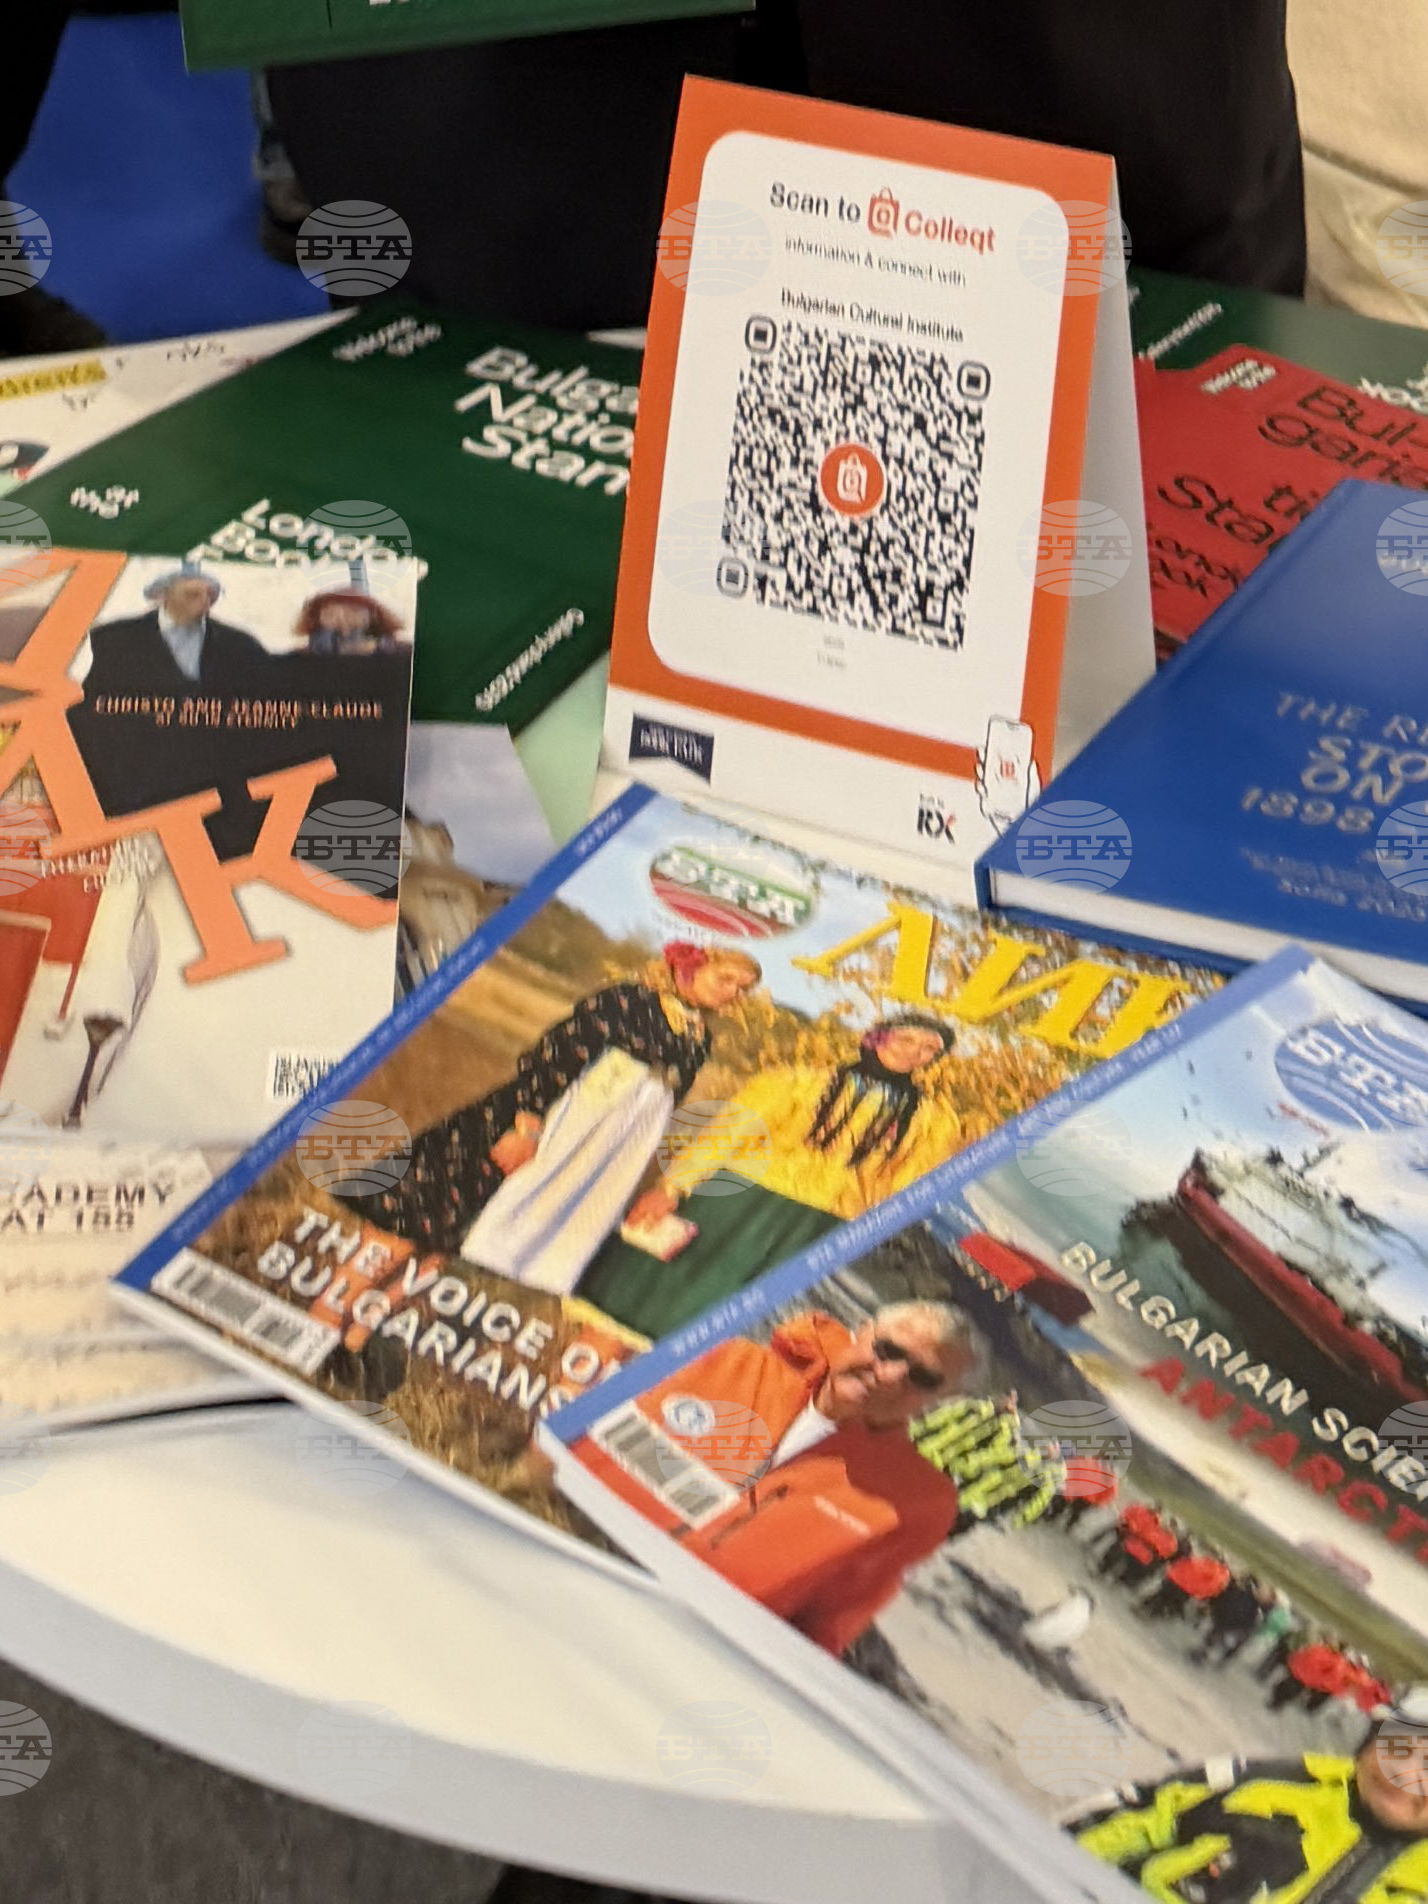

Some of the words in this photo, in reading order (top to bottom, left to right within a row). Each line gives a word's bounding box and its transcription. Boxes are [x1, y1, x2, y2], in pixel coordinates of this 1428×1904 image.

[770, 181, 829, 218] Scan
[838, 195, 861, 224] to
[785, 236, 860, 266] information
[864, 251, 874, 269] &
[878, 256, 933, 282] connect
[938, 270, 967, 287] with
[781, 287, 845, 319] Bulgarian
[850, 302, 903, 329] Cultural
[907, 314, 964, 343] Institute
[1157, 474, 1277, 547] Sta
[94, 694, 176, 716] CHRISTO
[1275, 690, 1370, 733] THE
[1239, 785, 1376, 836] 1898
[1299, 763, 1408, 808] ON
[917, 806, 957, 844] RX
[293, 1206, 392, 1278] THE
[401, 1256, 554, 1360] VOICE
[1061, 1240, 1309, 1420] BULGARIAN
